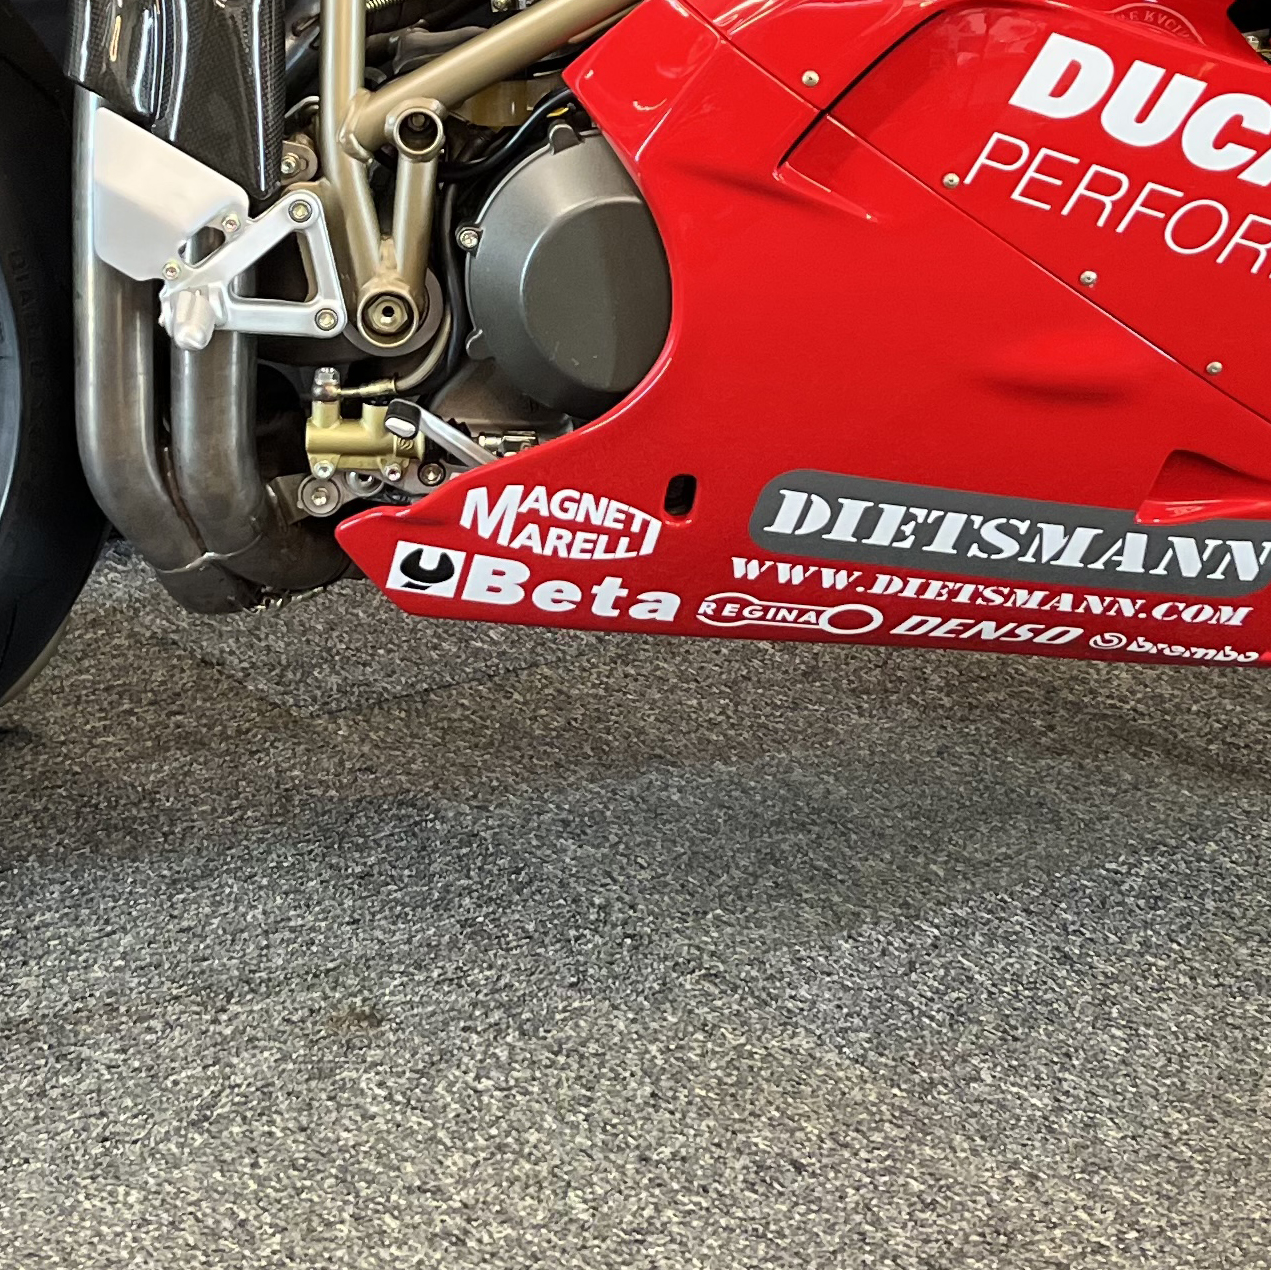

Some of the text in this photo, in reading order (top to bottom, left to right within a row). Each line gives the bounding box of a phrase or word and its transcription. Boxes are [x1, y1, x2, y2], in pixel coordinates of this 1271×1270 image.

[461, 553, 682, 623] Beta
[730, 556, 1253, 627] WWW.DIETSMANN.COM
[697, 600, 819, 625] REGINA
[890, 614, 1087, 646] DENSO
[1126, 636, 1260, 663] brembo
